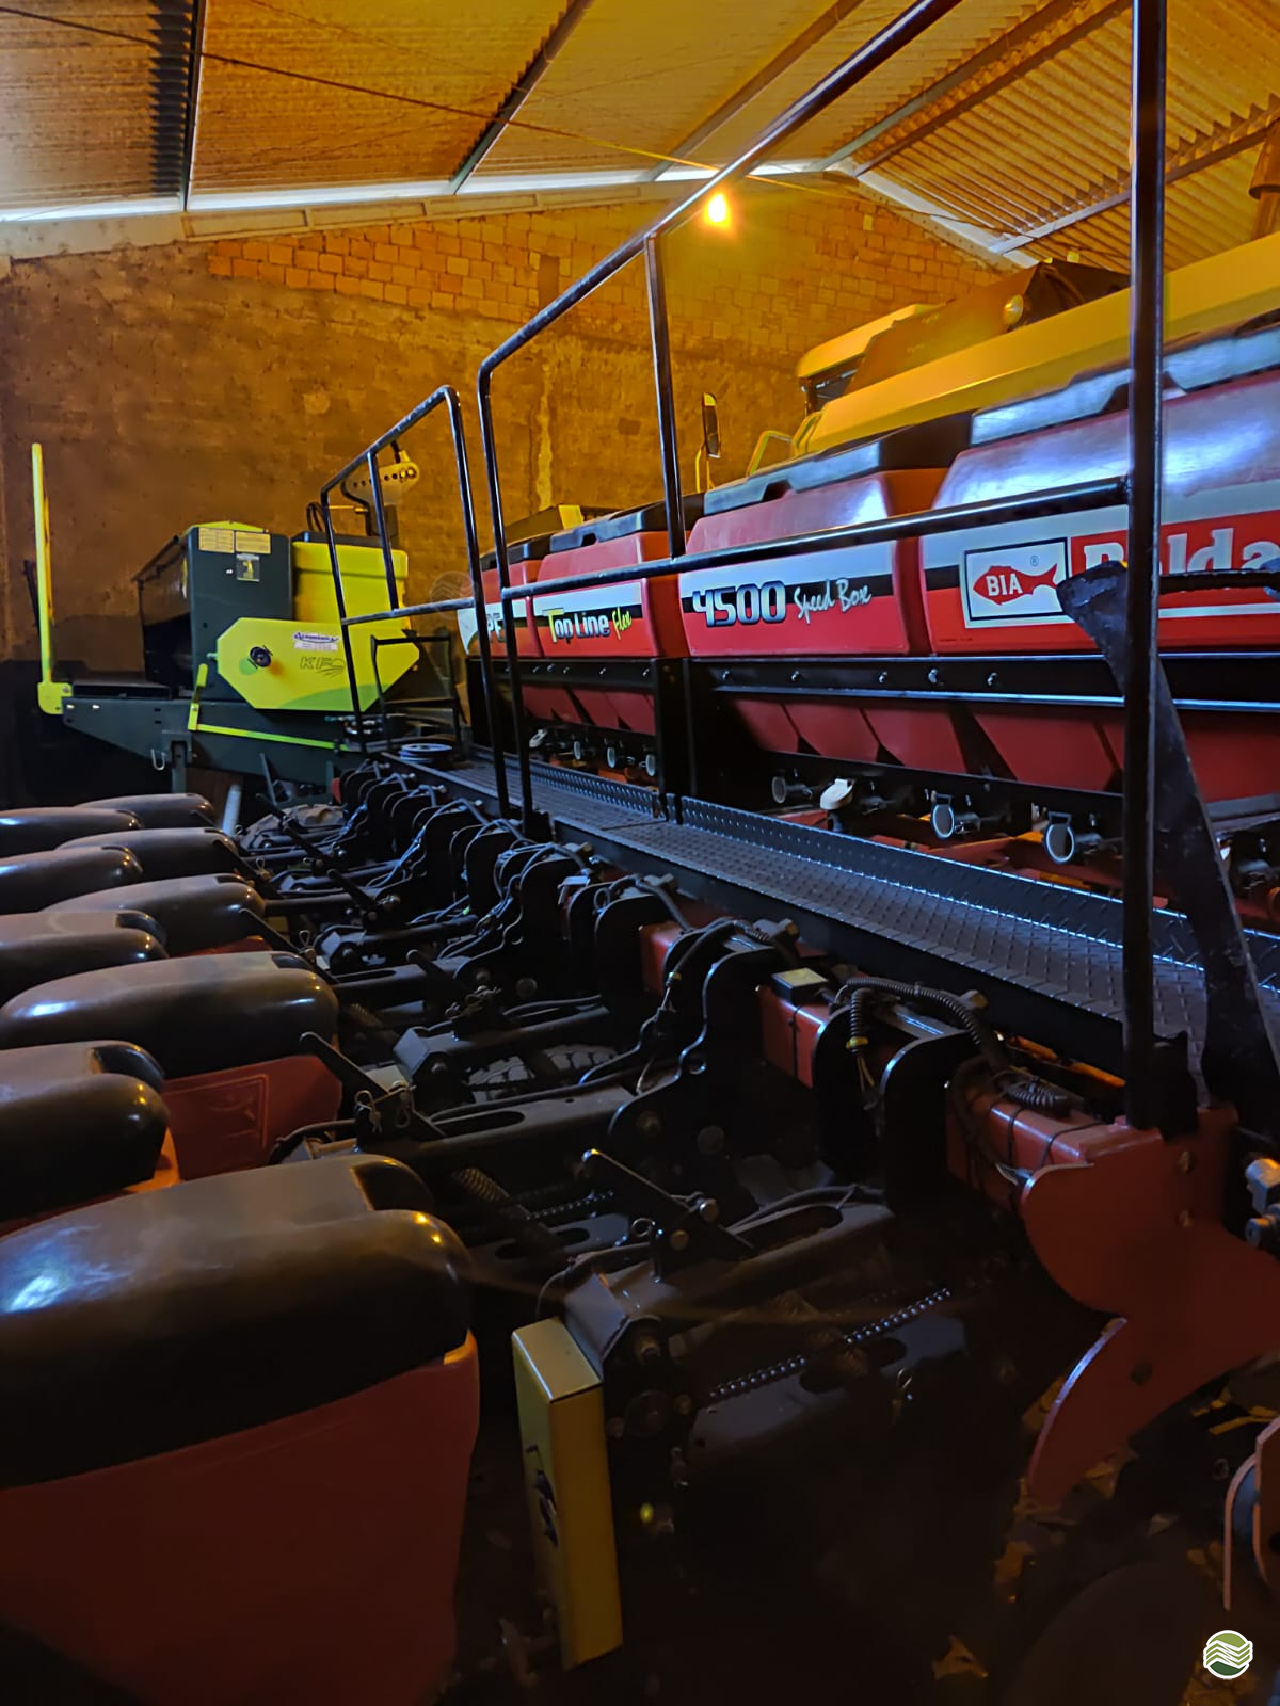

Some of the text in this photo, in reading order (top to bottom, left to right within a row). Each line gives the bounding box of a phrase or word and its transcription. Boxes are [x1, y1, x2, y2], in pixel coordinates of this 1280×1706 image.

[692, 577, 872, 627] 4500 Speed Box
[987, 573, 1023, 596] BIA
